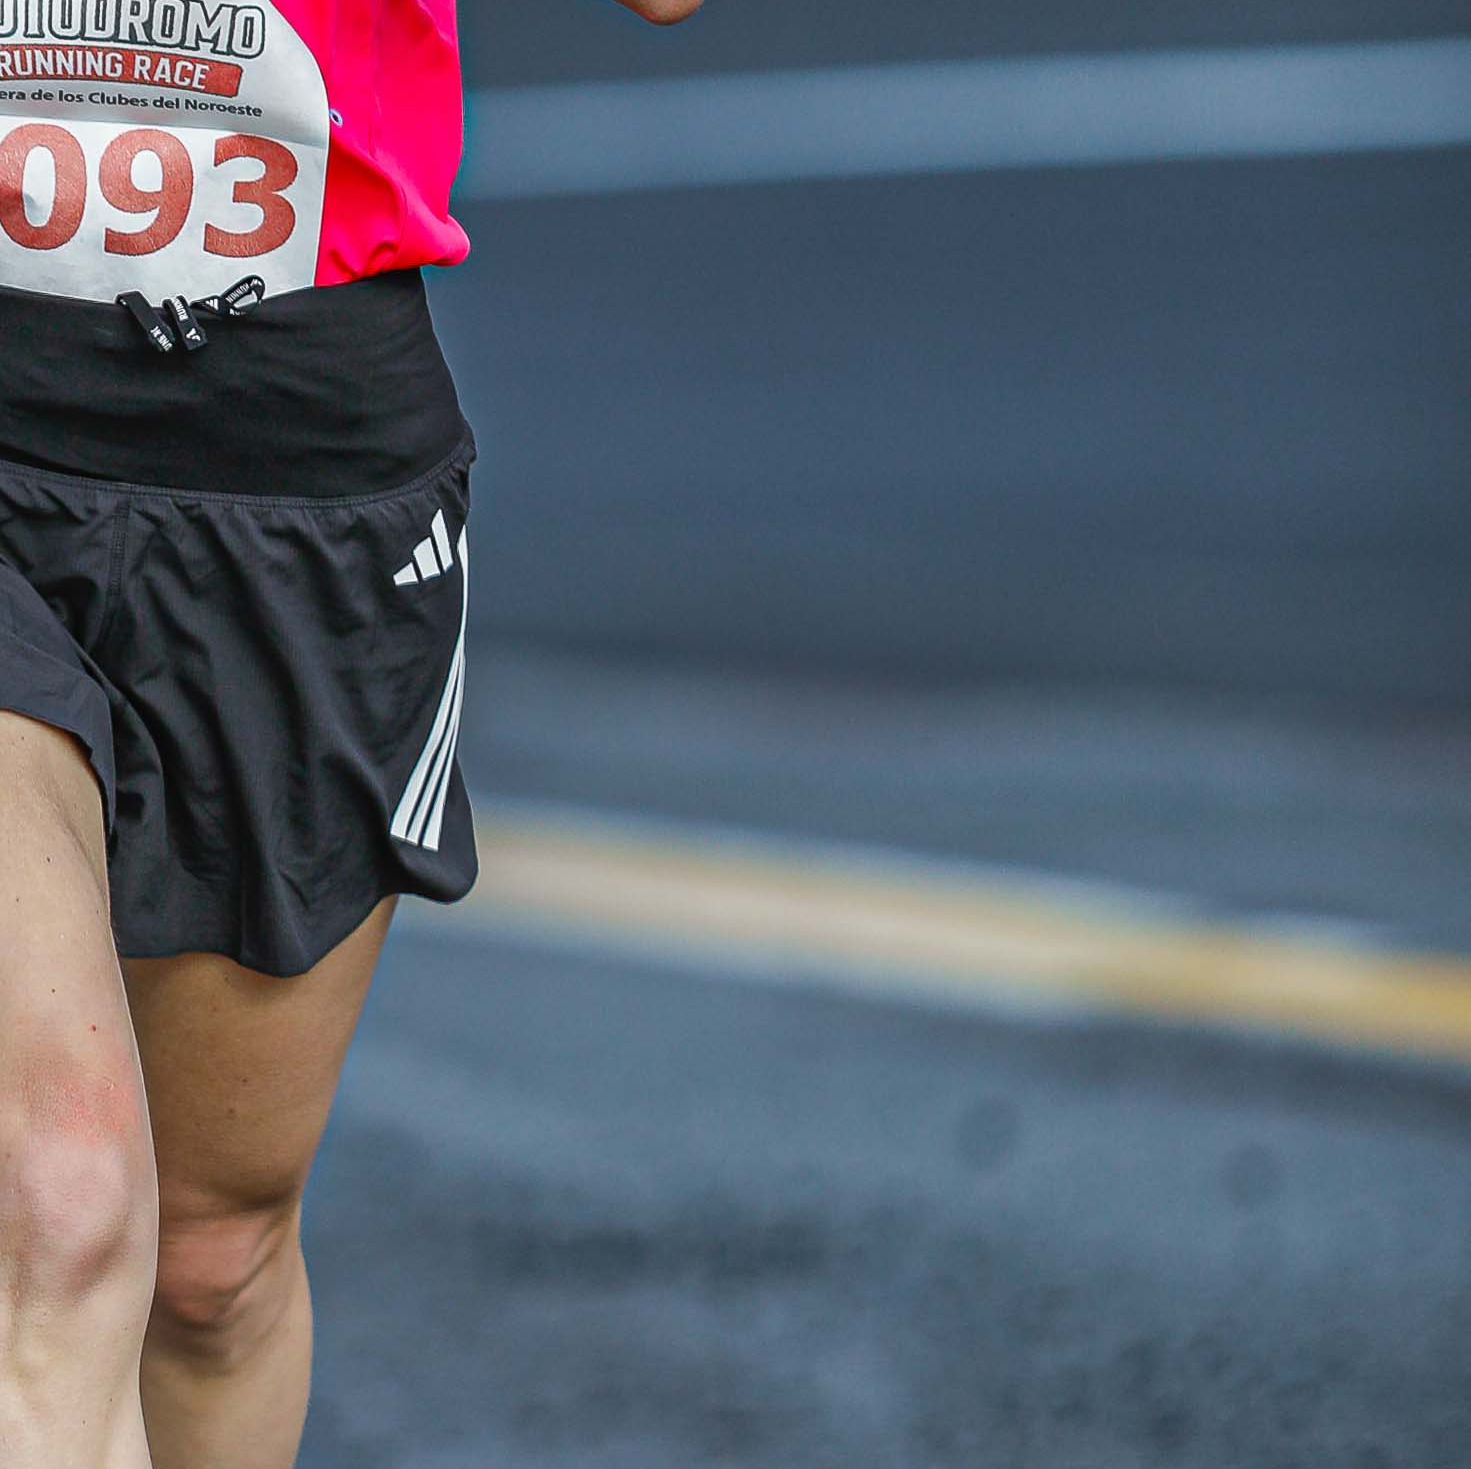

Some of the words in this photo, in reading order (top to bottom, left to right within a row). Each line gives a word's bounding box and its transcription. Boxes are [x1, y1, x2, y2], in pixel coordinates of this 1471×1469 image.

[133, 54, 210, 90] RACE
[30, 88, 54, 102] de
[58, 89, 84, 104] los
[88, 91, 149, 108] Clubes
[152, 95, 180, 109] del
[184, 99, 263, 117] Noroeste
